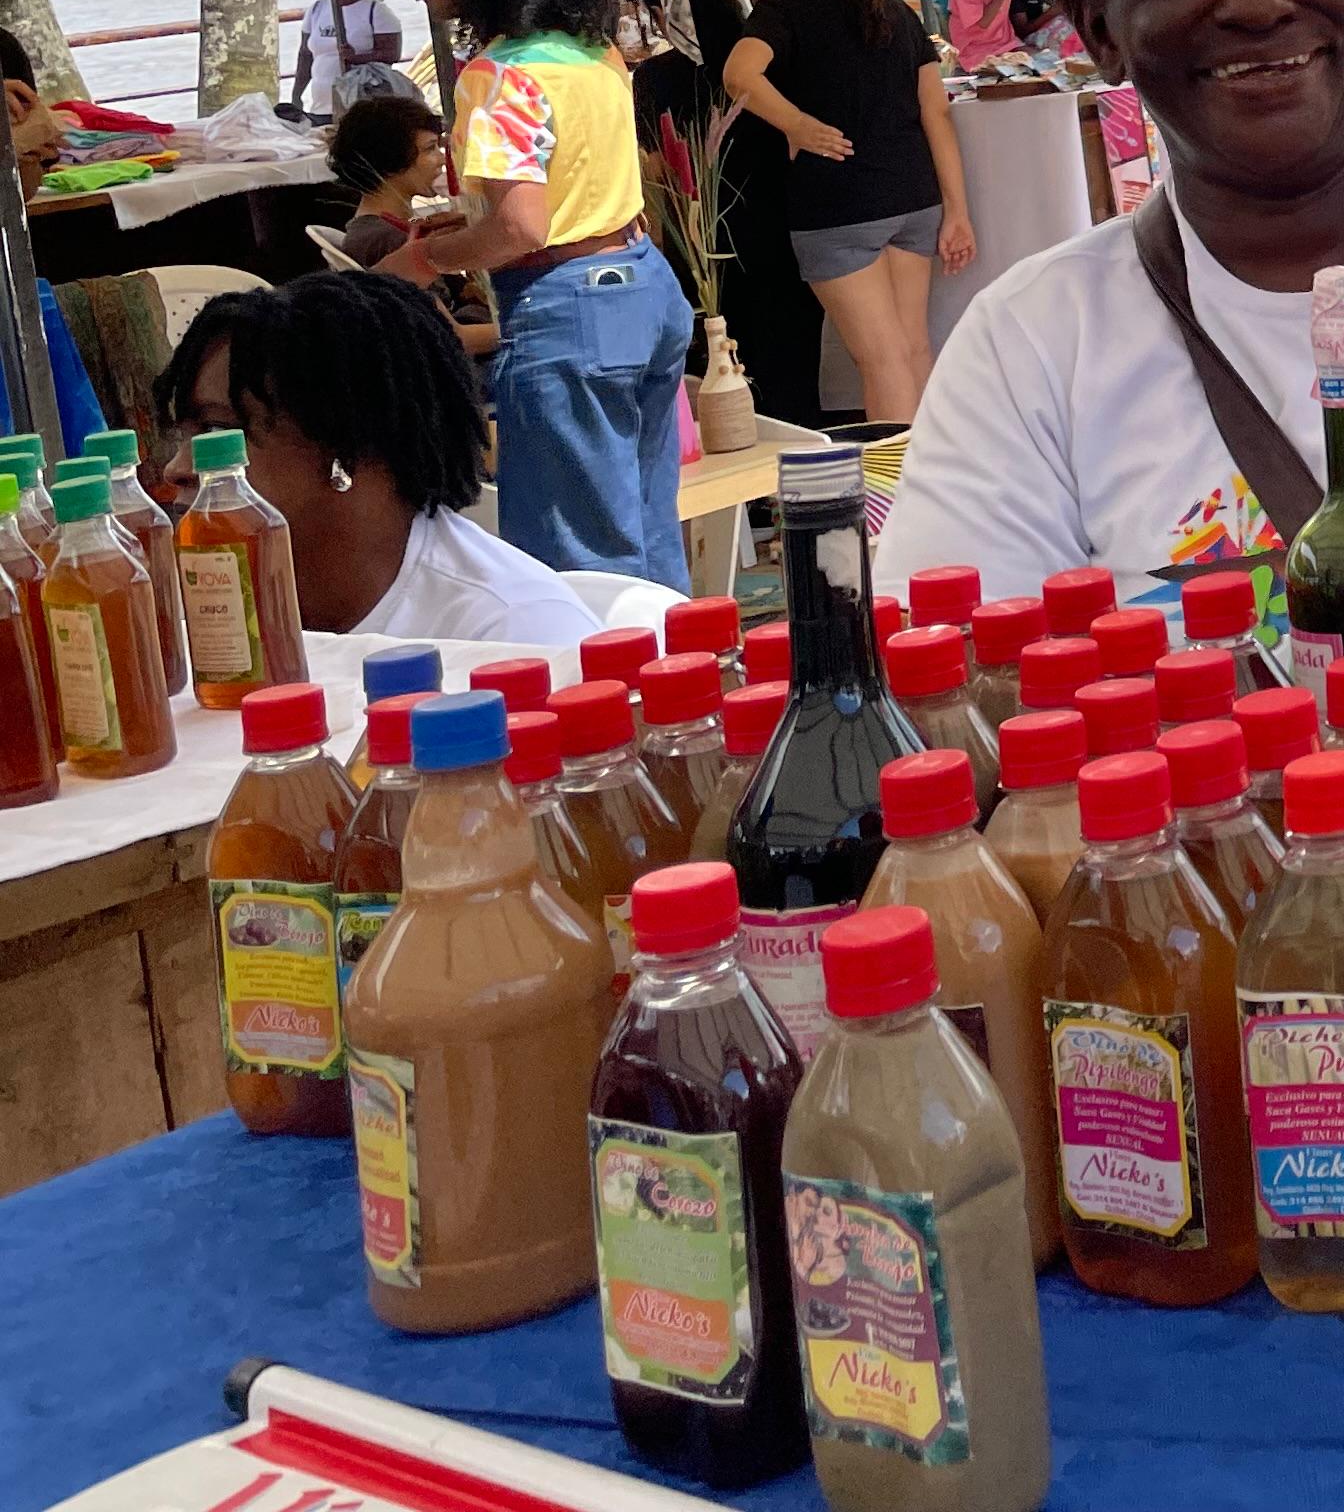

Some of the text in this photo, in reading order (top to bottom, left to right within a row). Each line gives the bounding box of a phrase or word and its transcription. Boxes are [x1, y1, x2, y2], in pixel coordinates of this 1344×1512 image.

[1265, 1092, 1317, 1103] Exclusivo
[1319, 1092, 1341, 1104] para
[1270, 1117, 1319, 1132] poderoso
[1080, 1151, 1166, 1192] Nicko's
[624, 1288, 712, 1338] Nicko's
[828, 1351, 918, 1405] Nicko's
